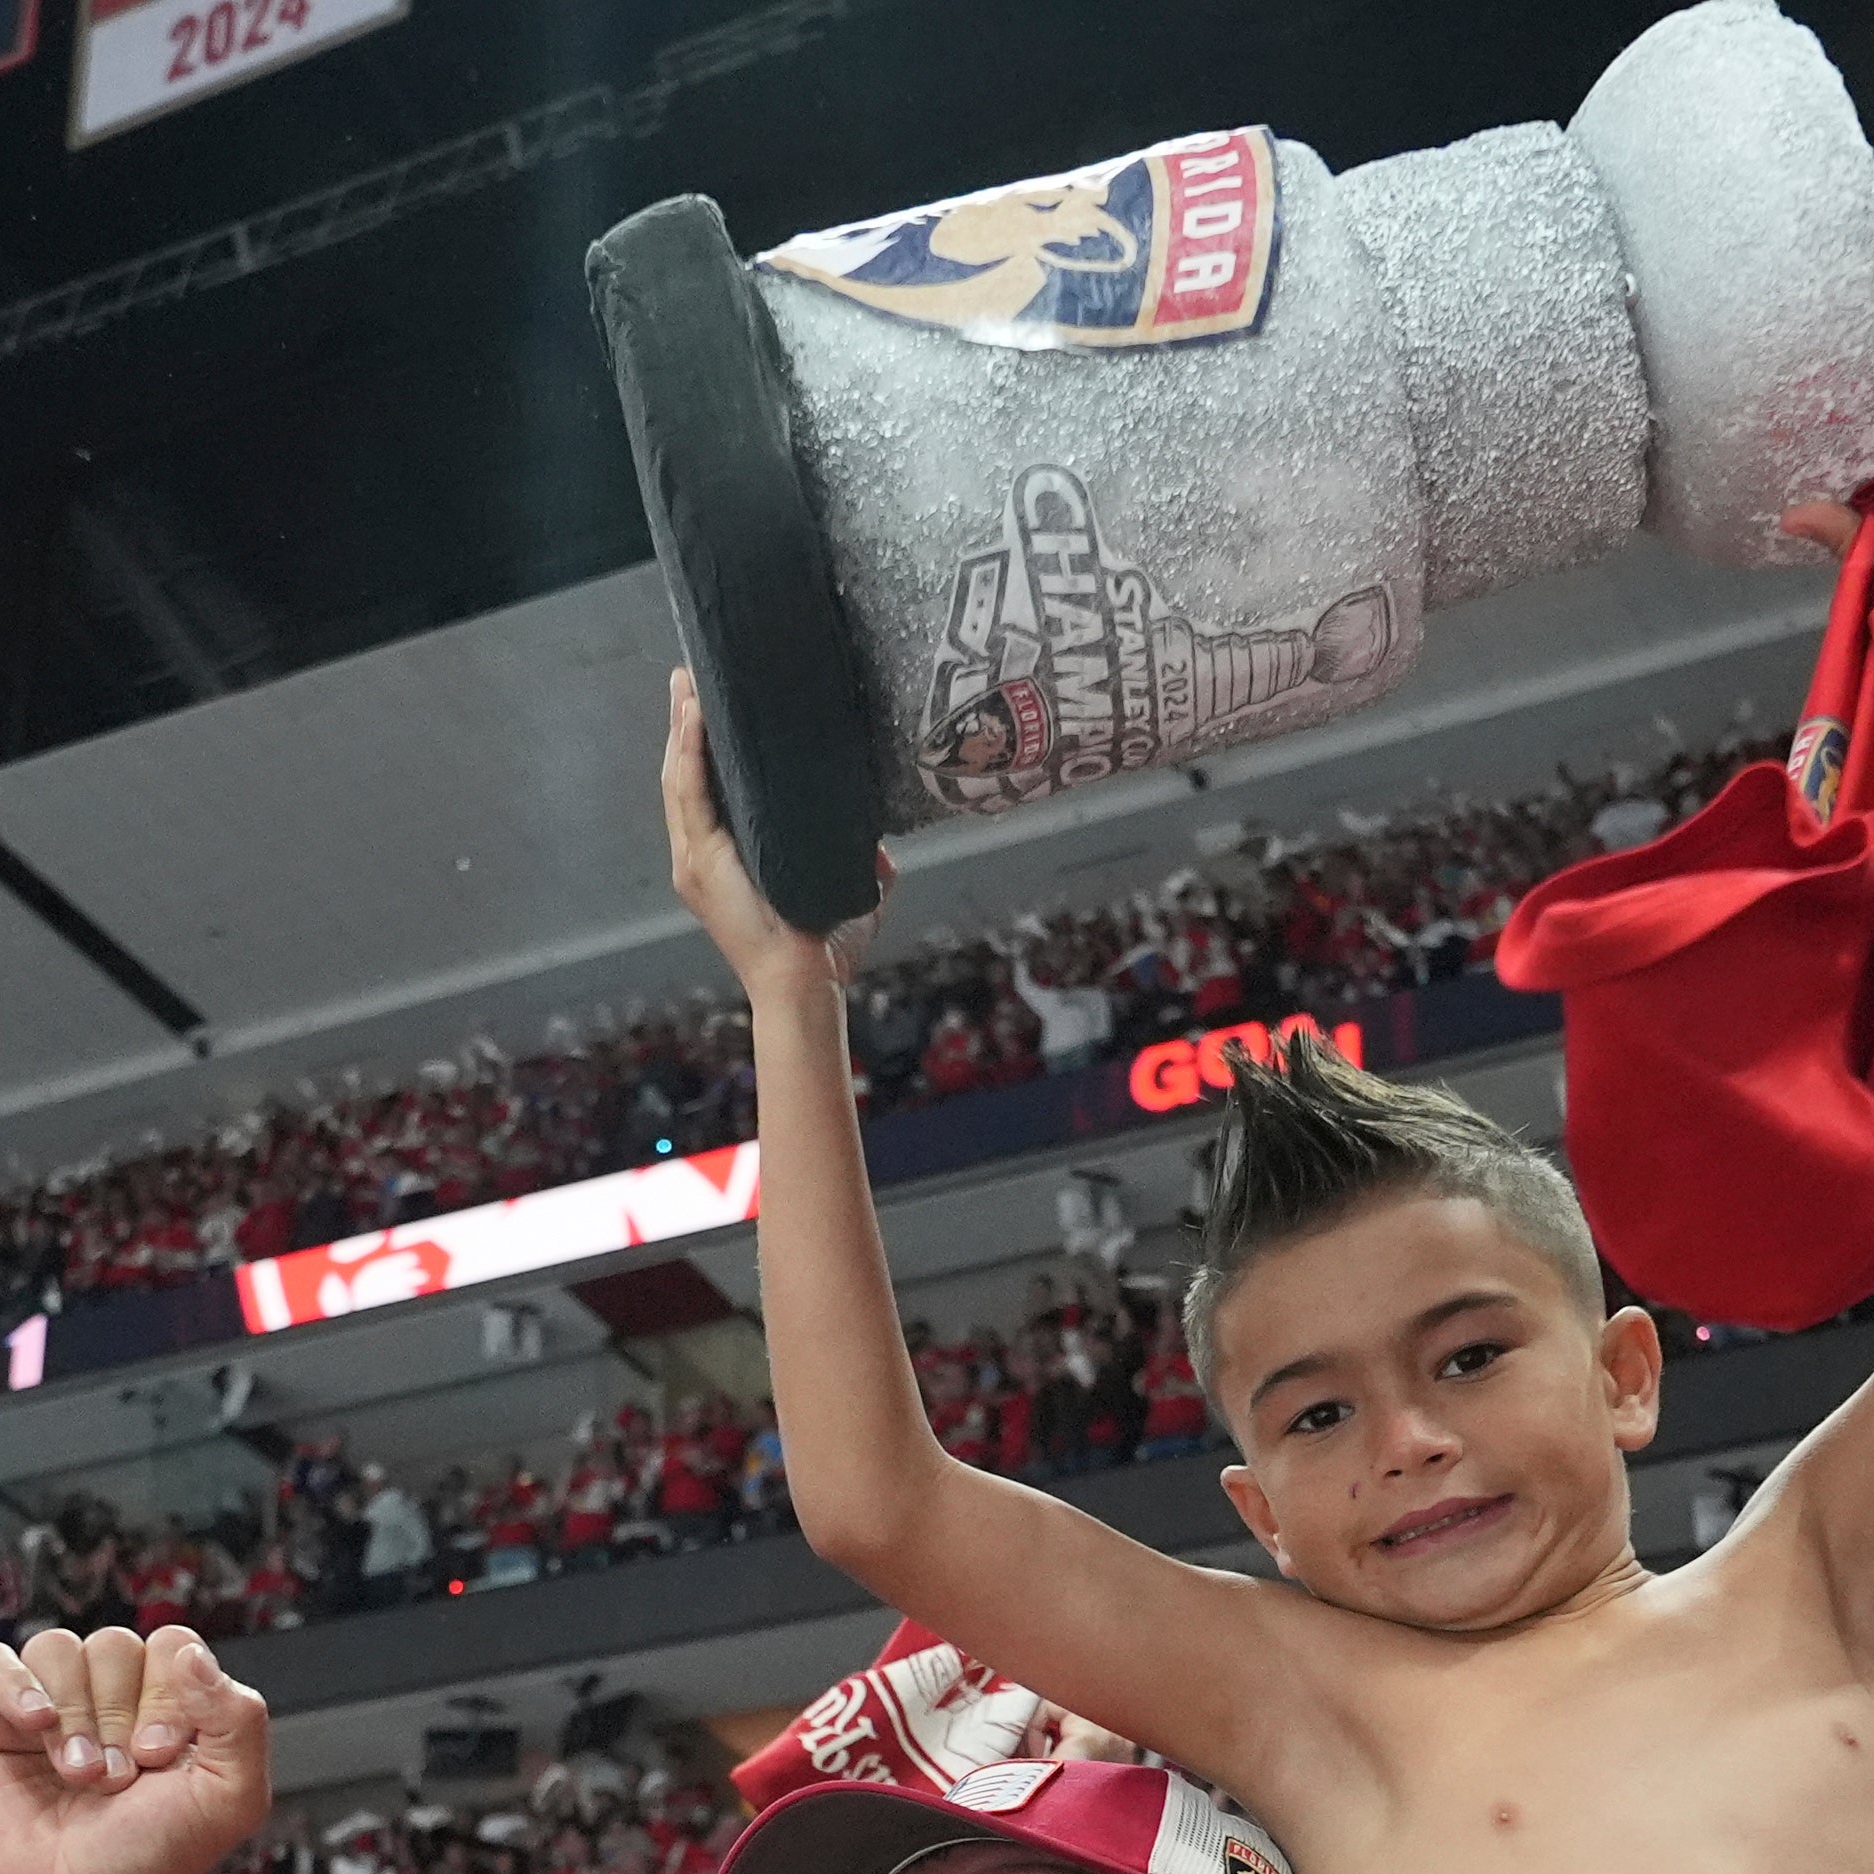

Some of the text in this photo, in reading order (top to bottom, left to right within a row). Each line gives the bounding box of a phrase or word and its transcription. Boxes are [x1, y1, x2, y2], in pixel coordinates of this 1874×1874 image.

[1023, 471, 1115, 787] CHAMPIO
[1106, 573, 1151, 730] STANLEY
[1161, 663, 1189, 723] 2024
